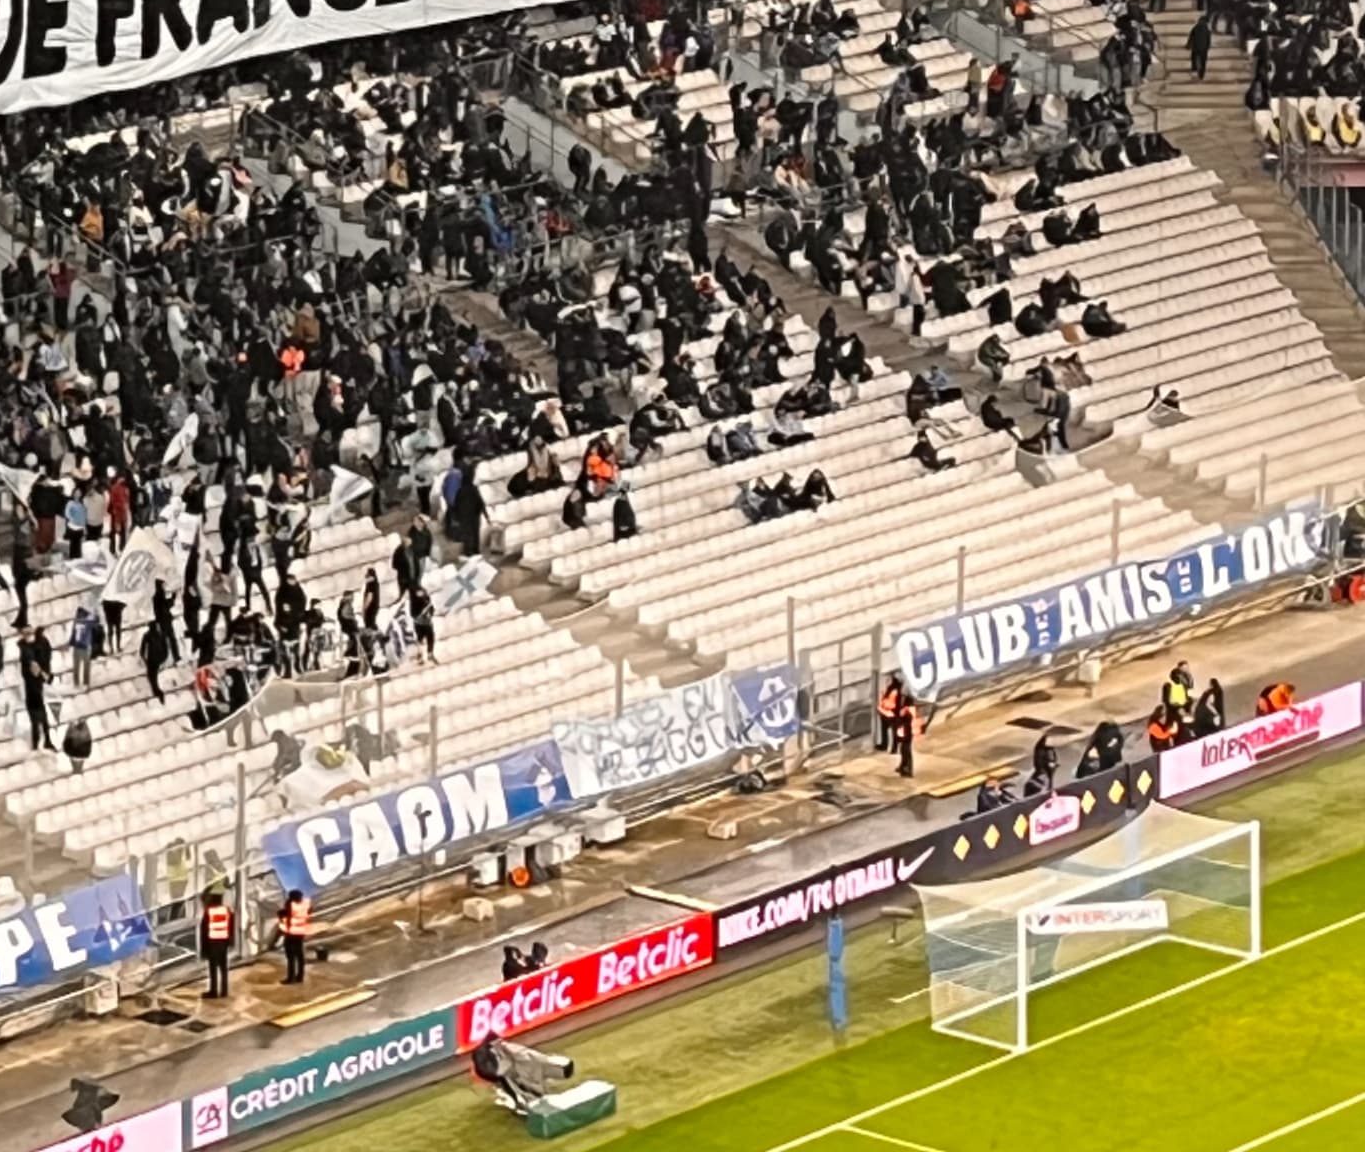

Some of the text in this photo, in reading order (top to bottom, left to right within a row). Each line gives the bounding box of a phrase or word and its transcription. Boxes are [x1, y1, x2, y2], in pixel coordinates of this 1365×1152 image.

[898, 604, 1031, 688] CLUB
[1059, 561, 1168, 644] AMIS
[1198, 512, 1316, 597] L'OM
[294, 765, 508, 888] CAOM
[469, 971, 574, 1041] Betclic
[597, 926, 699, 993] Betclic
[230, 1069, 319, 1121] CRÉDIT
[323, 1024, 444, 1088] AGRICOLE
